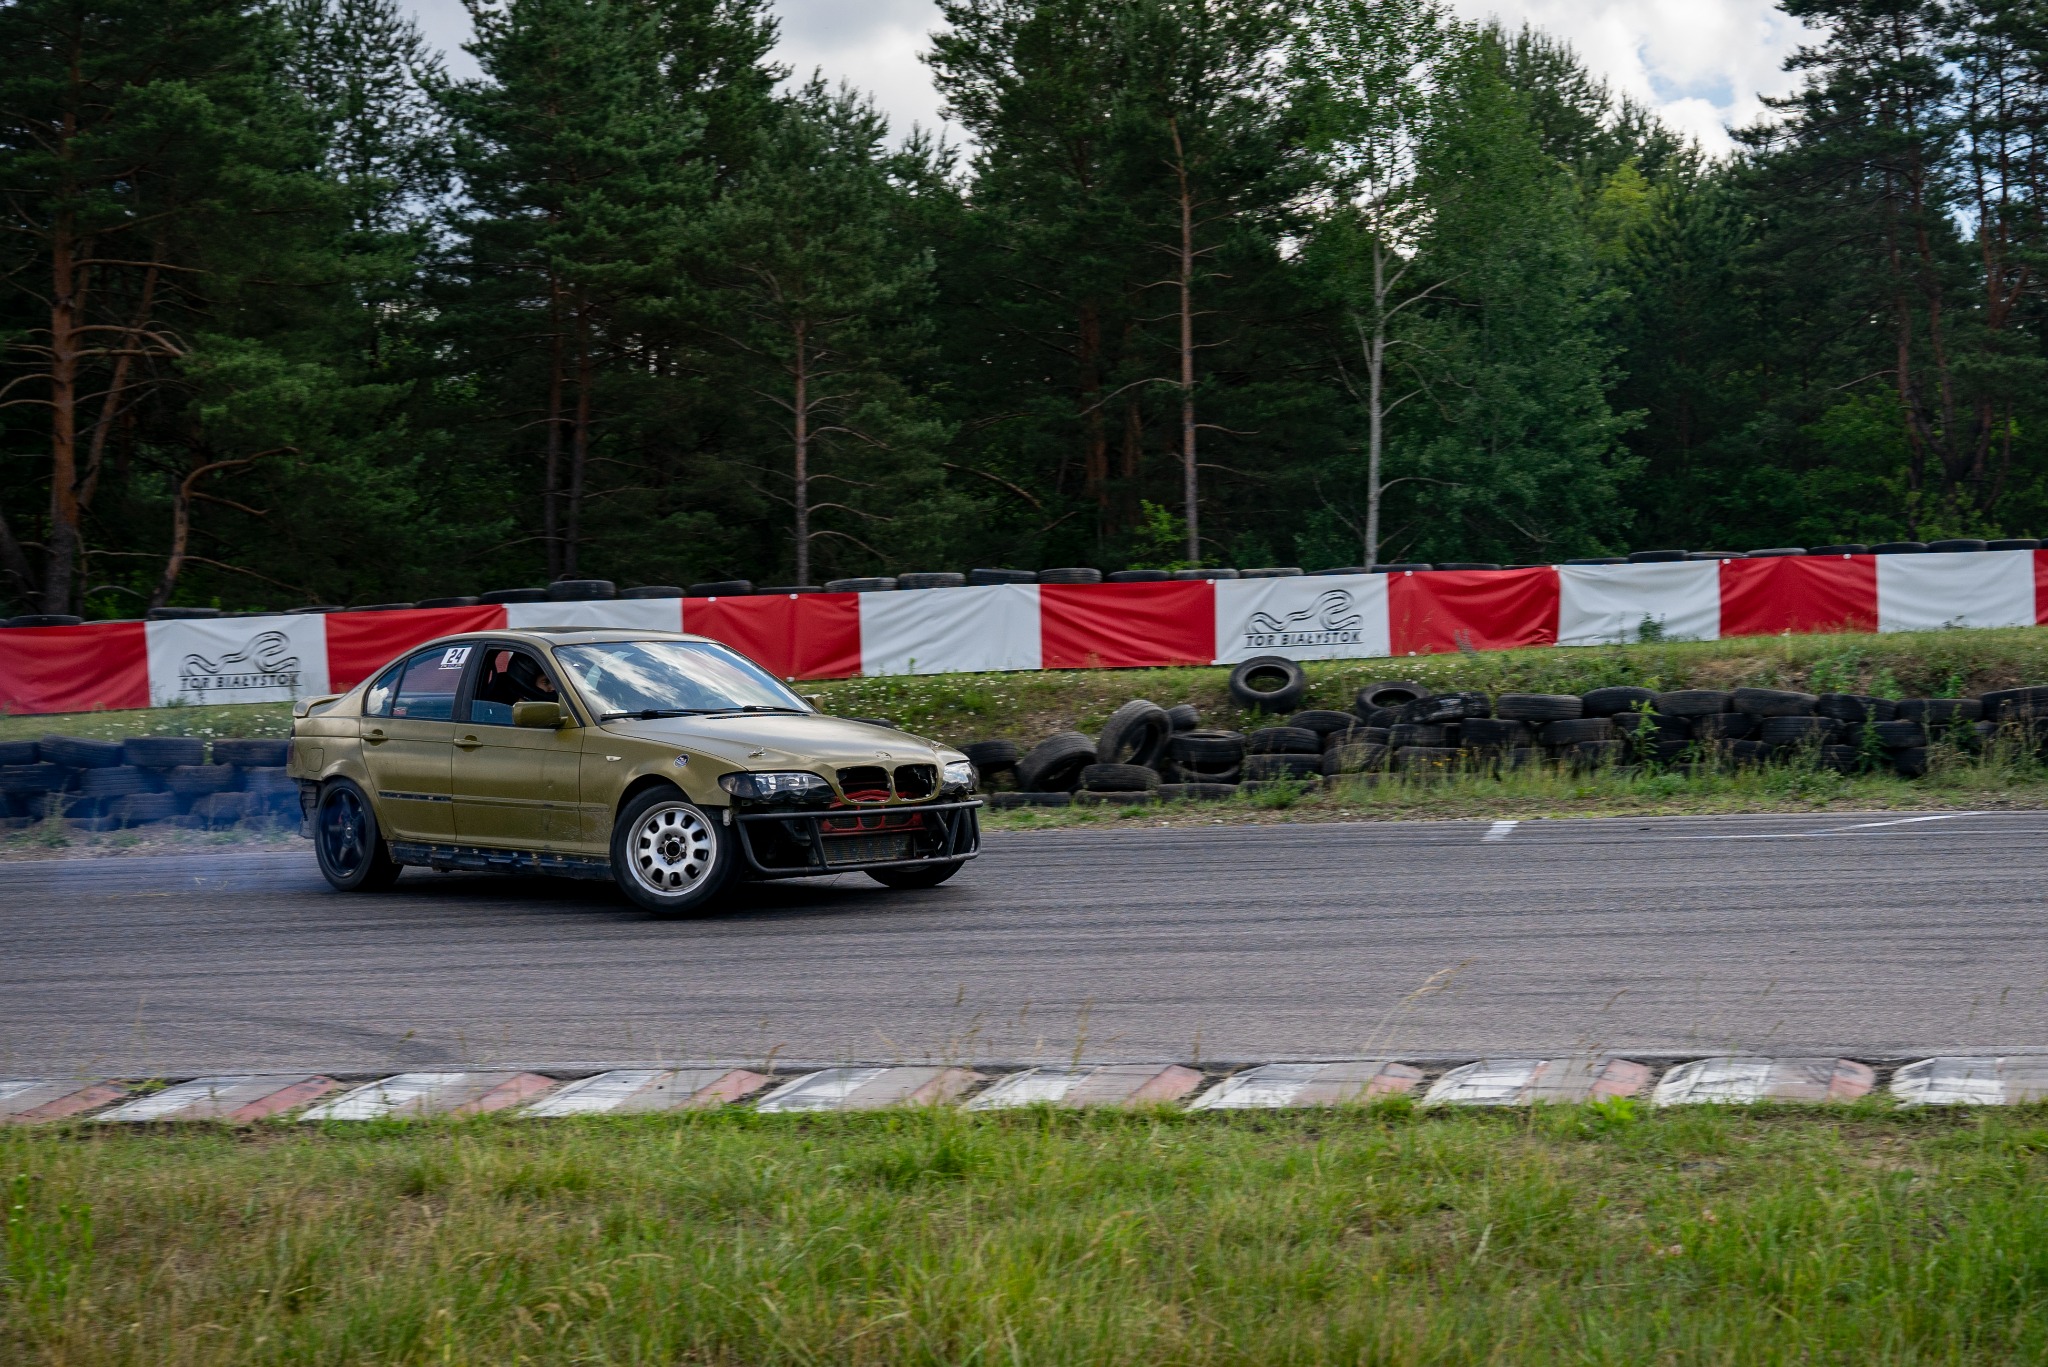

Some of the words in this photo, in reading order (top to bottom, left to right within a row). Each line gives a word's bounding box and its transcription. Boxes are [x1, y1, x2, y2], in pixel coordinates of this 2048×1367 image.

[1247, 635, 1274, 646] TOR
[1281, 631, 1360, 645] BIAŁYSTOK
[447, 649, 465, 664] 24
[181, 677, 210, 689] TOR
